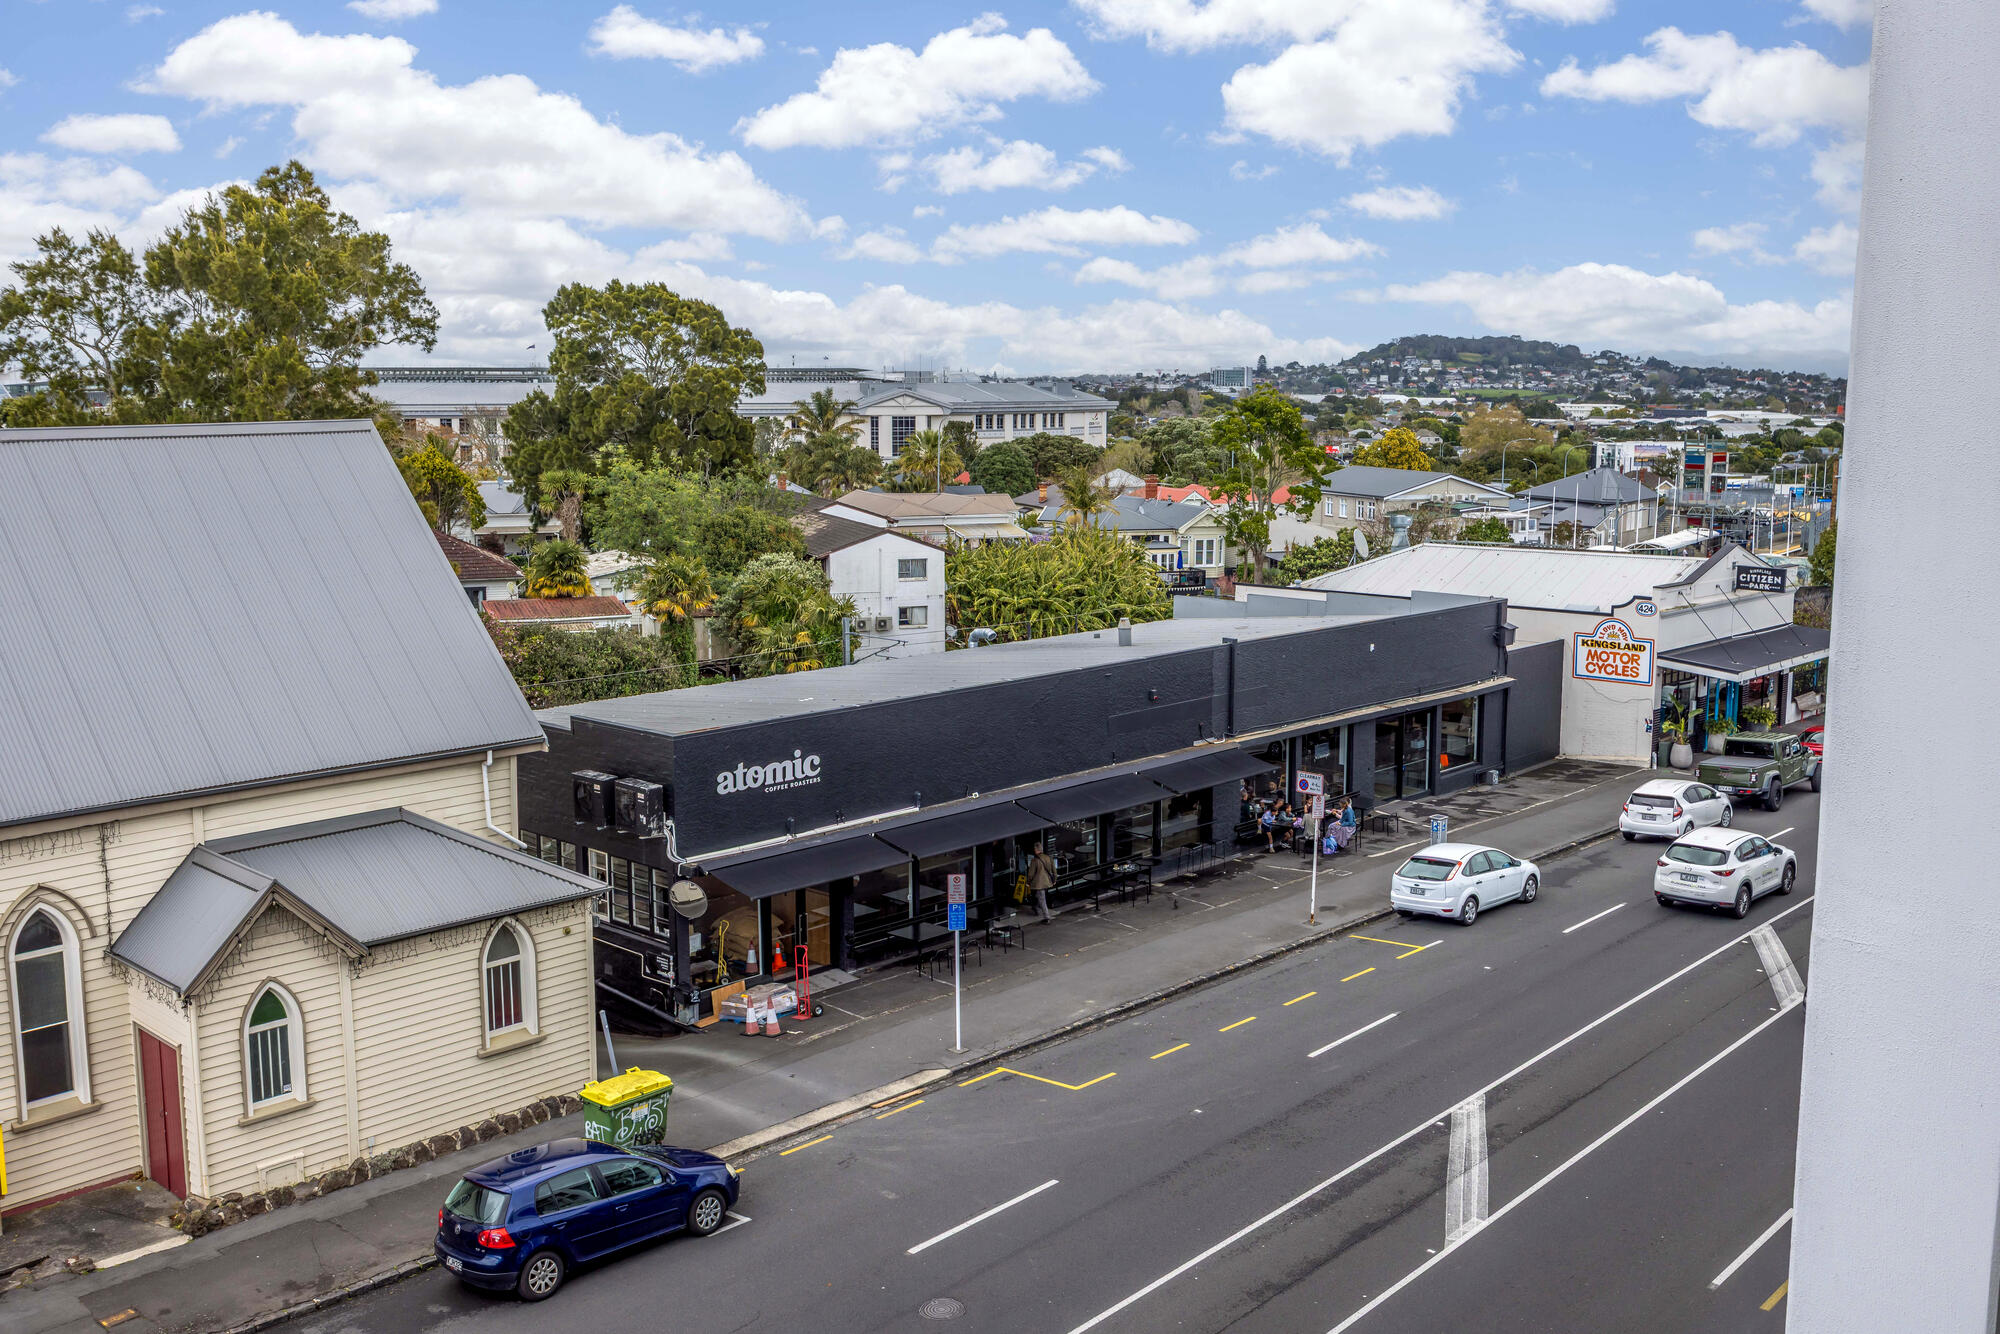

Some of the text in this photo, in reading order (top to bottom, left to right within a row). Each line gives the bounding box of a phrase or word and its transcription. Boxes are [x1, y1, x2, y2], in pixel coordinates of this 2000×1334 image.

[1740, 573, 1782, 585] CITIZEN
[1749, 582, 1770, 590] PARK
[1638, 604, 1654, 614] 424
[1598, 624, 1617, 639] LLOYD
[1586, 649, 1640, 666] MOTOR
[1585, 661, 1639, 678] CYCLES
[716, 749, 821, 795] atomic
[764, 776, 821, 793] COFFEE ROASTERS
[585, 1120, 612, 1142] BAT
